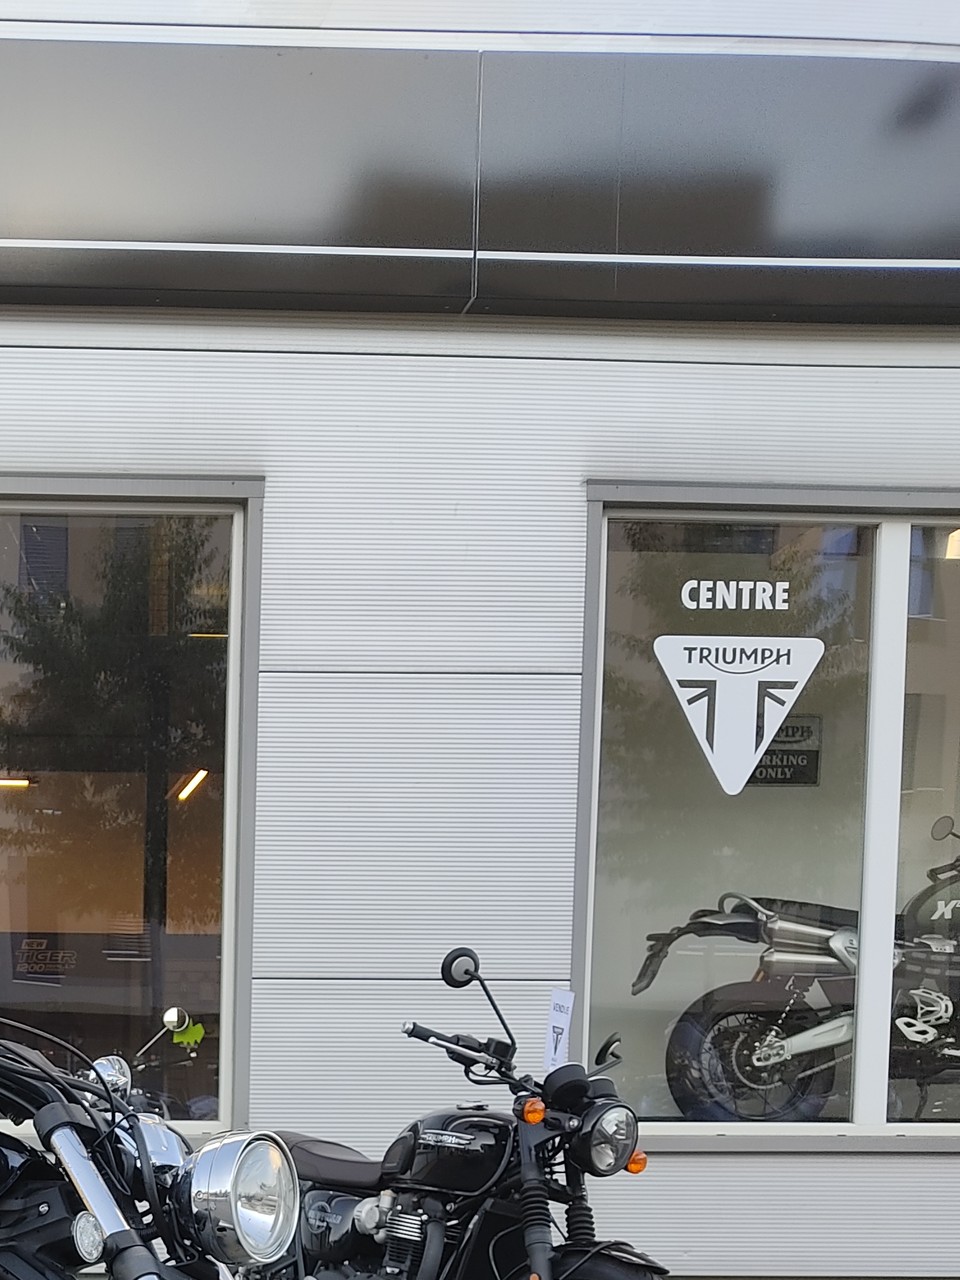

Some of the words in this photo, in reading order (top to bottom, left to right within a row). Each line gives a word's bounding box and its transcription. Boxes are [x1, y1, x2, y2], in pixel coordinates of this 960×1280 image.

[681, 580, 789, 610] CENTRE
[684, 646, 791, 666] TRIUMPH
[760, 755, 808, 766] RKING
[755, 767, 793, 779] ONLY
[15, 950, 77, 964] TIGER
[16, 963, 46, 972] 1200
